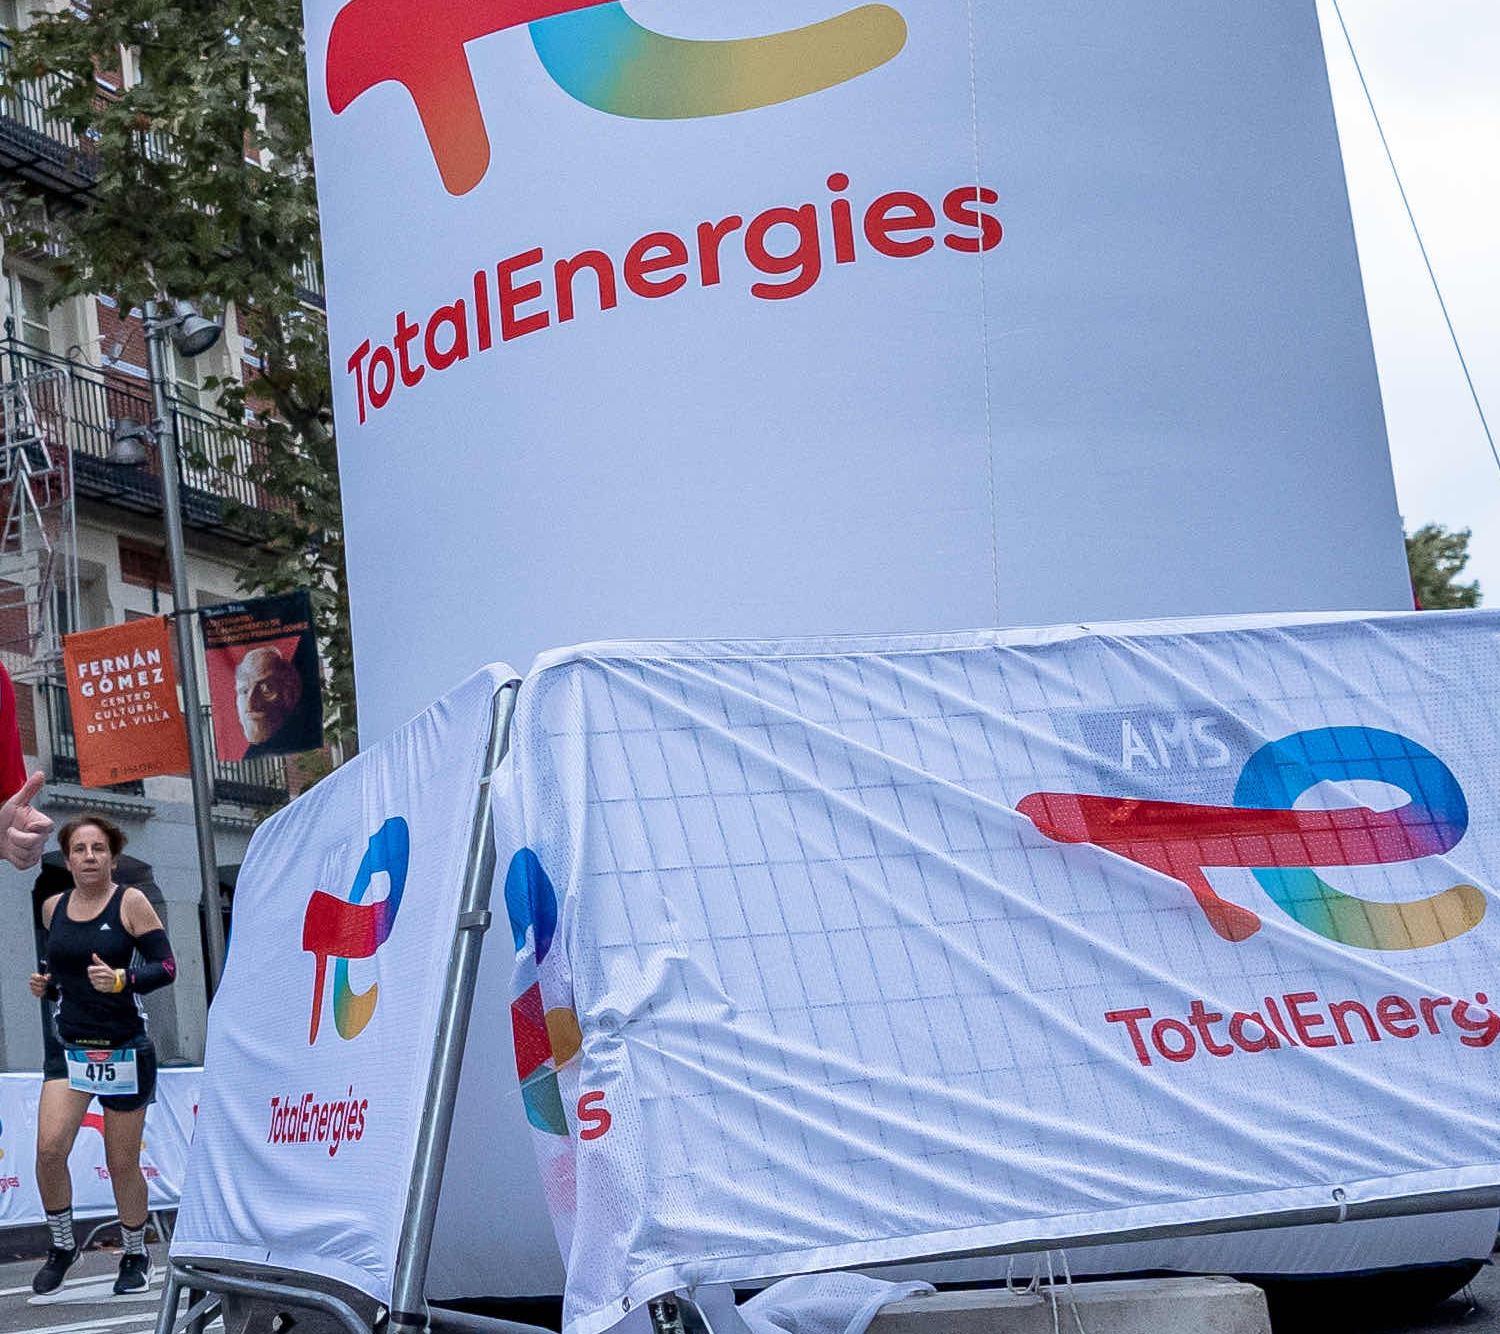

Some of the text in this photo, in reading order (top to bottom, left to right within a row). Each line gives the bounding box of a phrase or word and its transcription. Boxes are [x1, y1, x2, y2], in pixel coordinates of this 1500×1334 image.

[347, 171, 1004, 425] TotalEnergies
[78, 648, 161, 678] FERNÁN
[81, 667, 164, 697] GÓMEZ
[95, 700, 160, 721] CULTURAL
[101, 690, 151, 707] CENTRO
[87, 711, 170, 734] DE LA VILLA
[1120, 717, 1231, 772] AMS
[85, 1063, 116, 1082] 475
[267, 1086, 369, 1157] TotalEnergies
